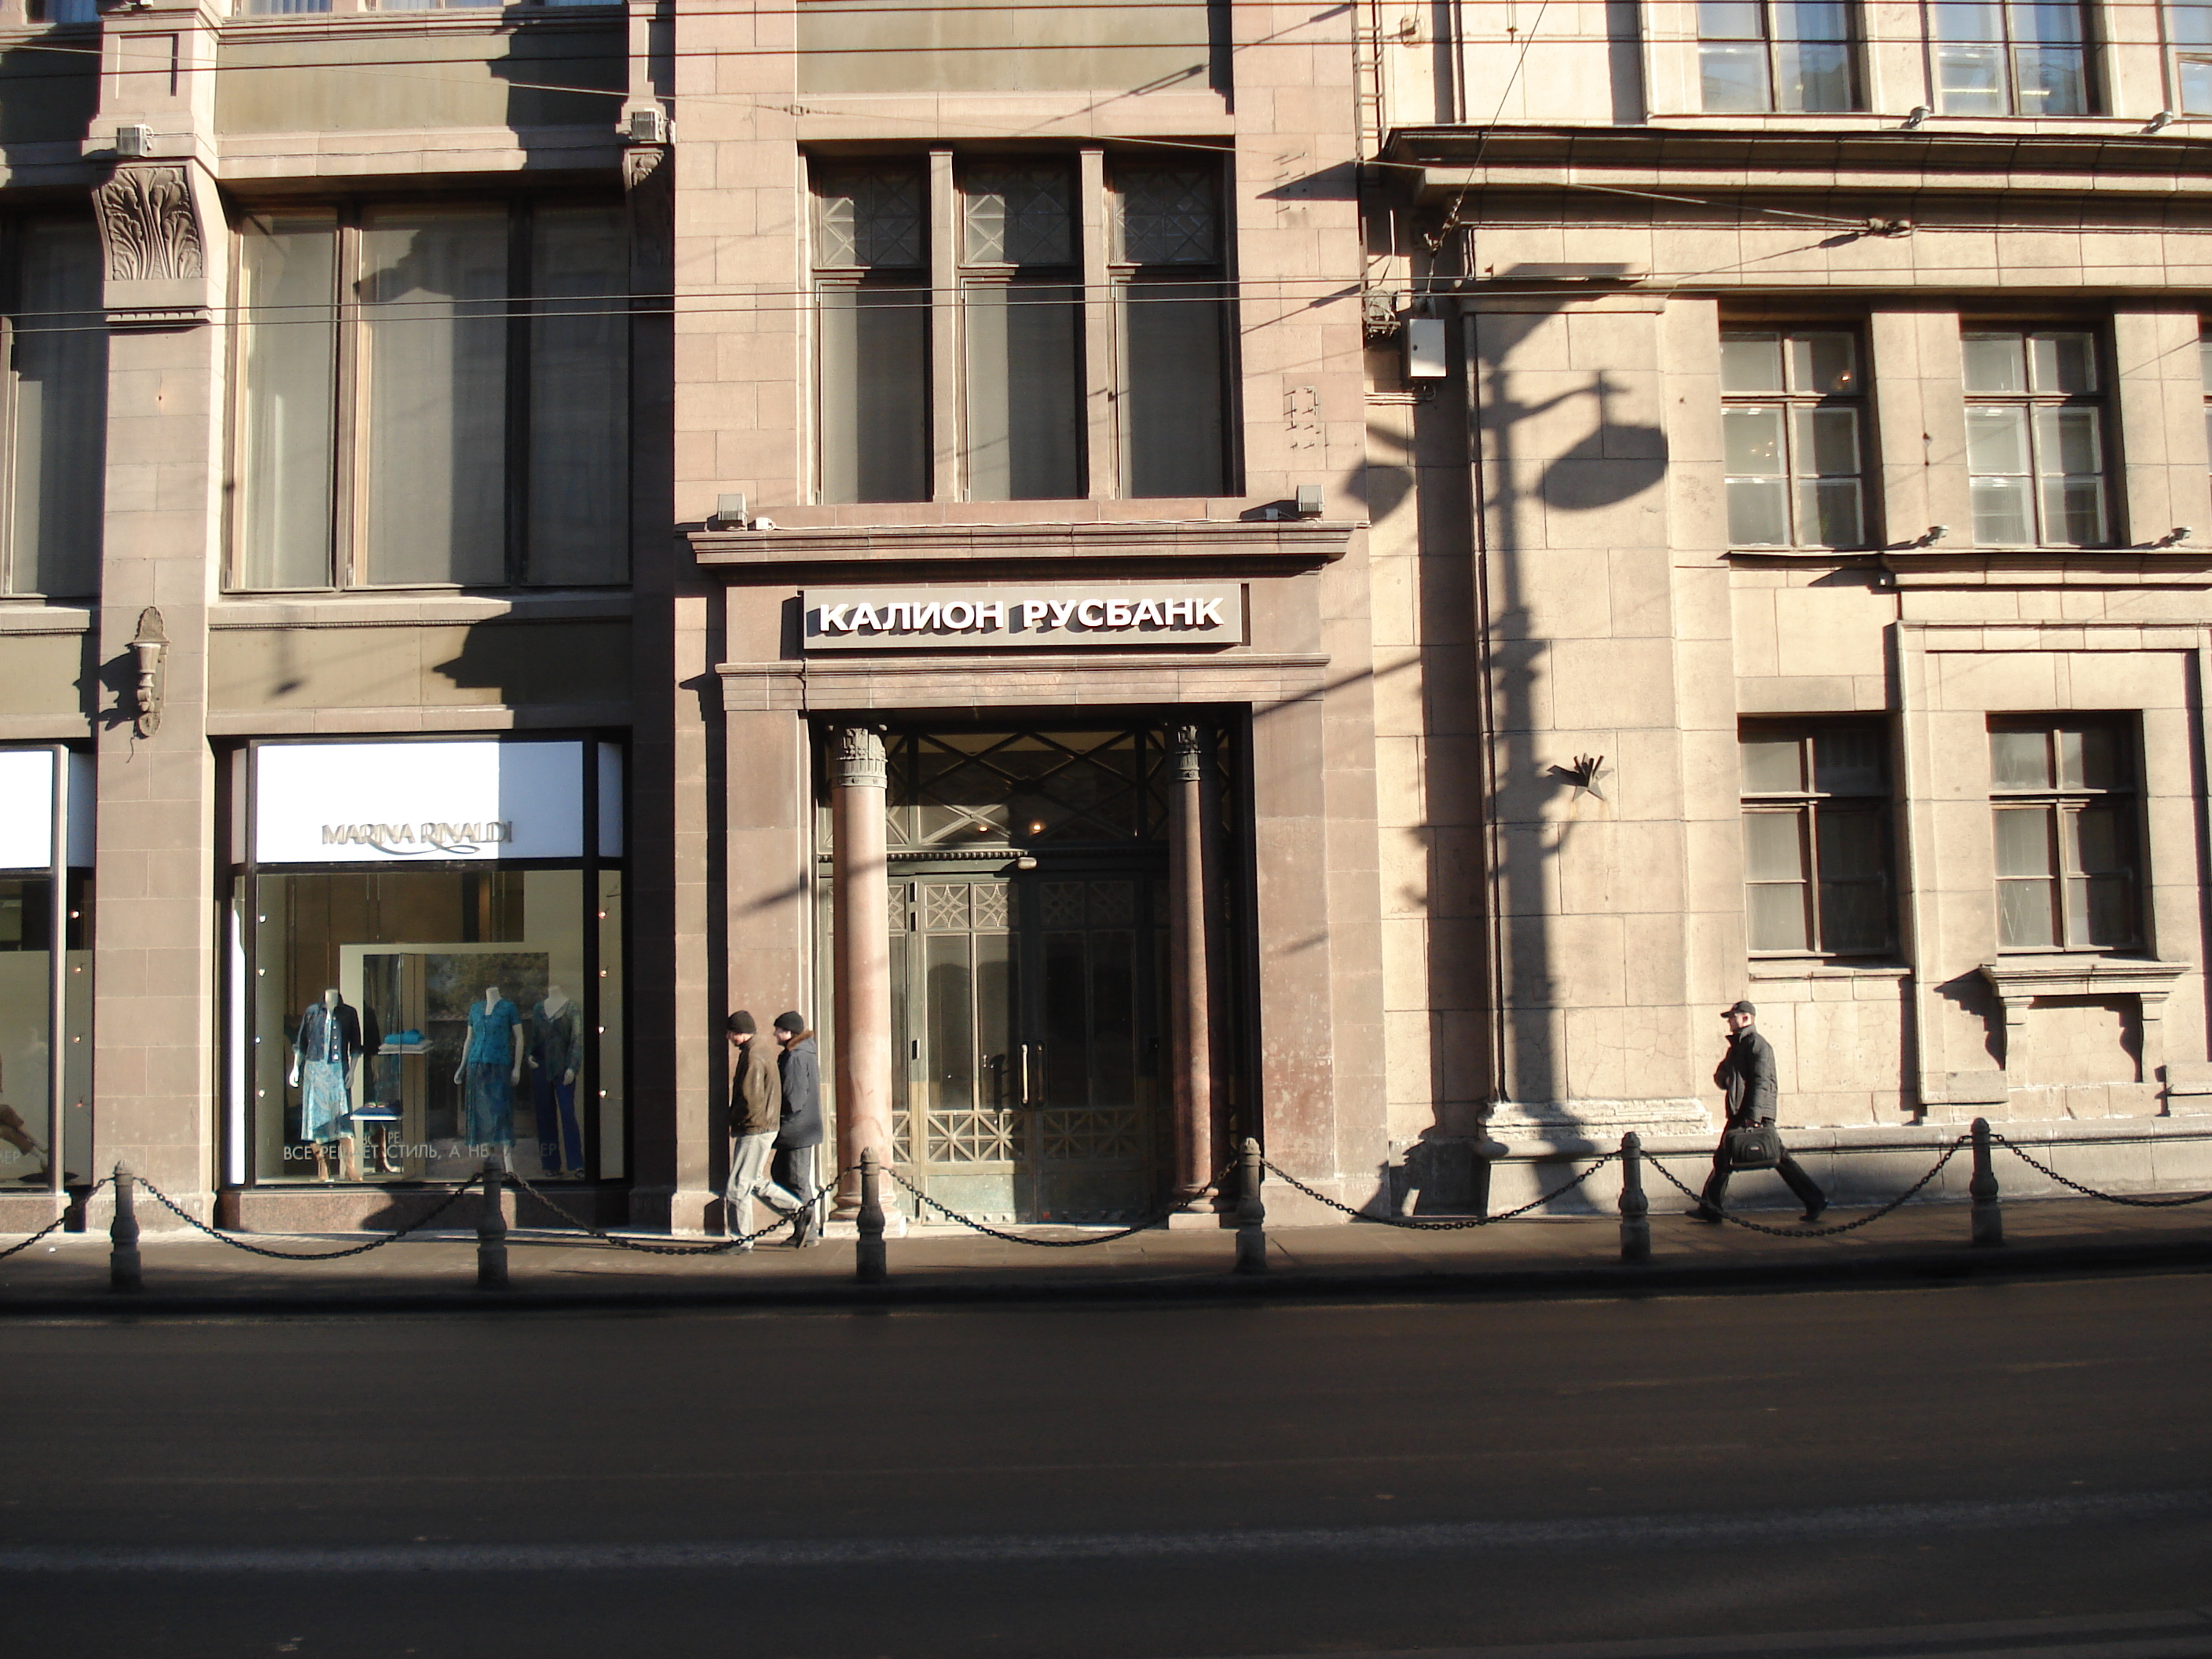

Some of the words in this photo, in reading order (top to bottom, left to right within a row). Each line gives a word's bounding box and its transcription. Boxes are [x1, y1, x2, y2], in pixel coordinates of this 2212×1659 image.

[819, 600, 1005, 632] КАЛИОН
[1022, 597, 1225, 628] РУСБАНК
[321, 823, 416, 855] MARINA
[420, 821, 513, 852] RINALDI
[284, 1145, 313, 1160] ВСЕ
[322, 1144, 379, 1160] РЕАЕТ
[386, 1144, 441, 1160] СТИЛЬ,
[449, 1144, 461, 1158] А
